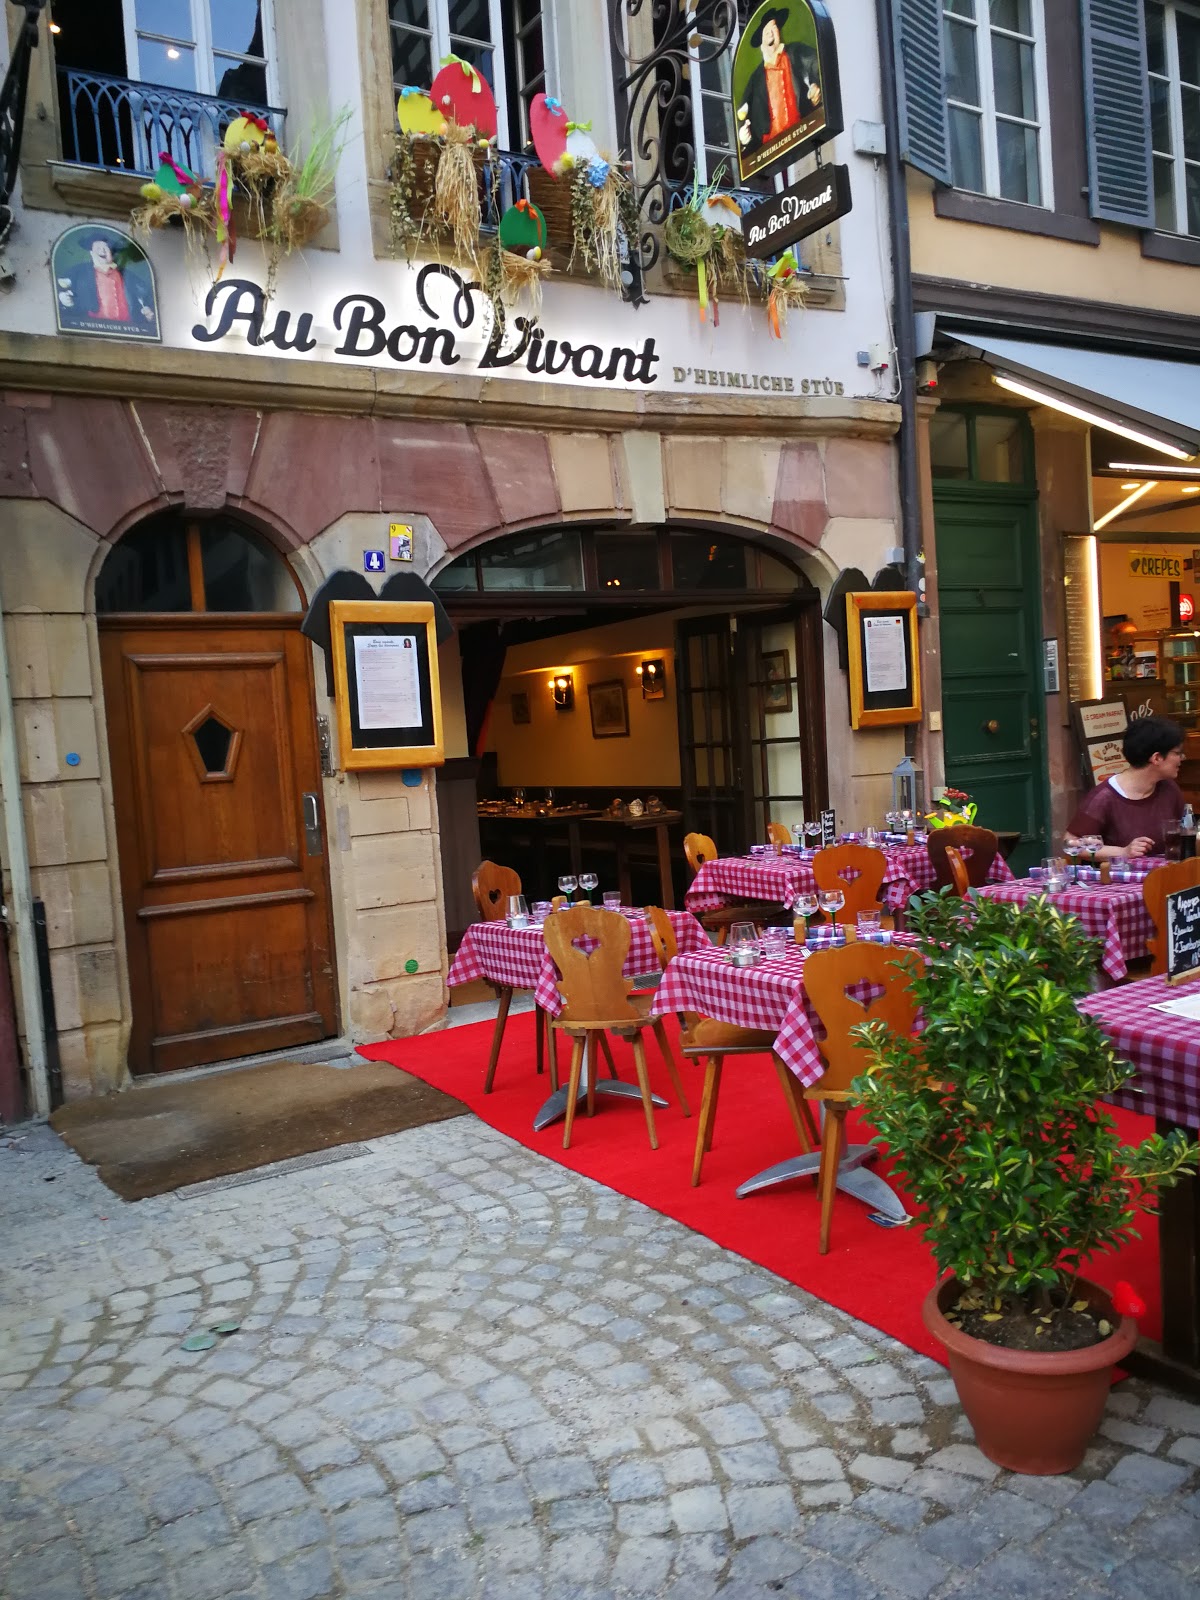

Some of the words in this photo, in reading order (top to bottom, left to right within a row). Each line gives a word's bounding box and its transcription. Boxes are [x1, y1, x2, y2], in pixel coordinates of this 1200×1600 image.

[757, 133, 792, 162] D'HEIMLICHE
[748, 225, 767, 247] Au
[768, 213, 791, 235] Bon
[781, 184, 833, 220] Vivant
[191, 278, 316, 351] Au
[333, 293, 461, 366] Bon
[416, 263, 660, 385] Vivant
[672, 366, 795, 392] D'HEIMLICHE
[370, 553, 380, 569] 4
[1141, 557, 1181, 577] CREPES
